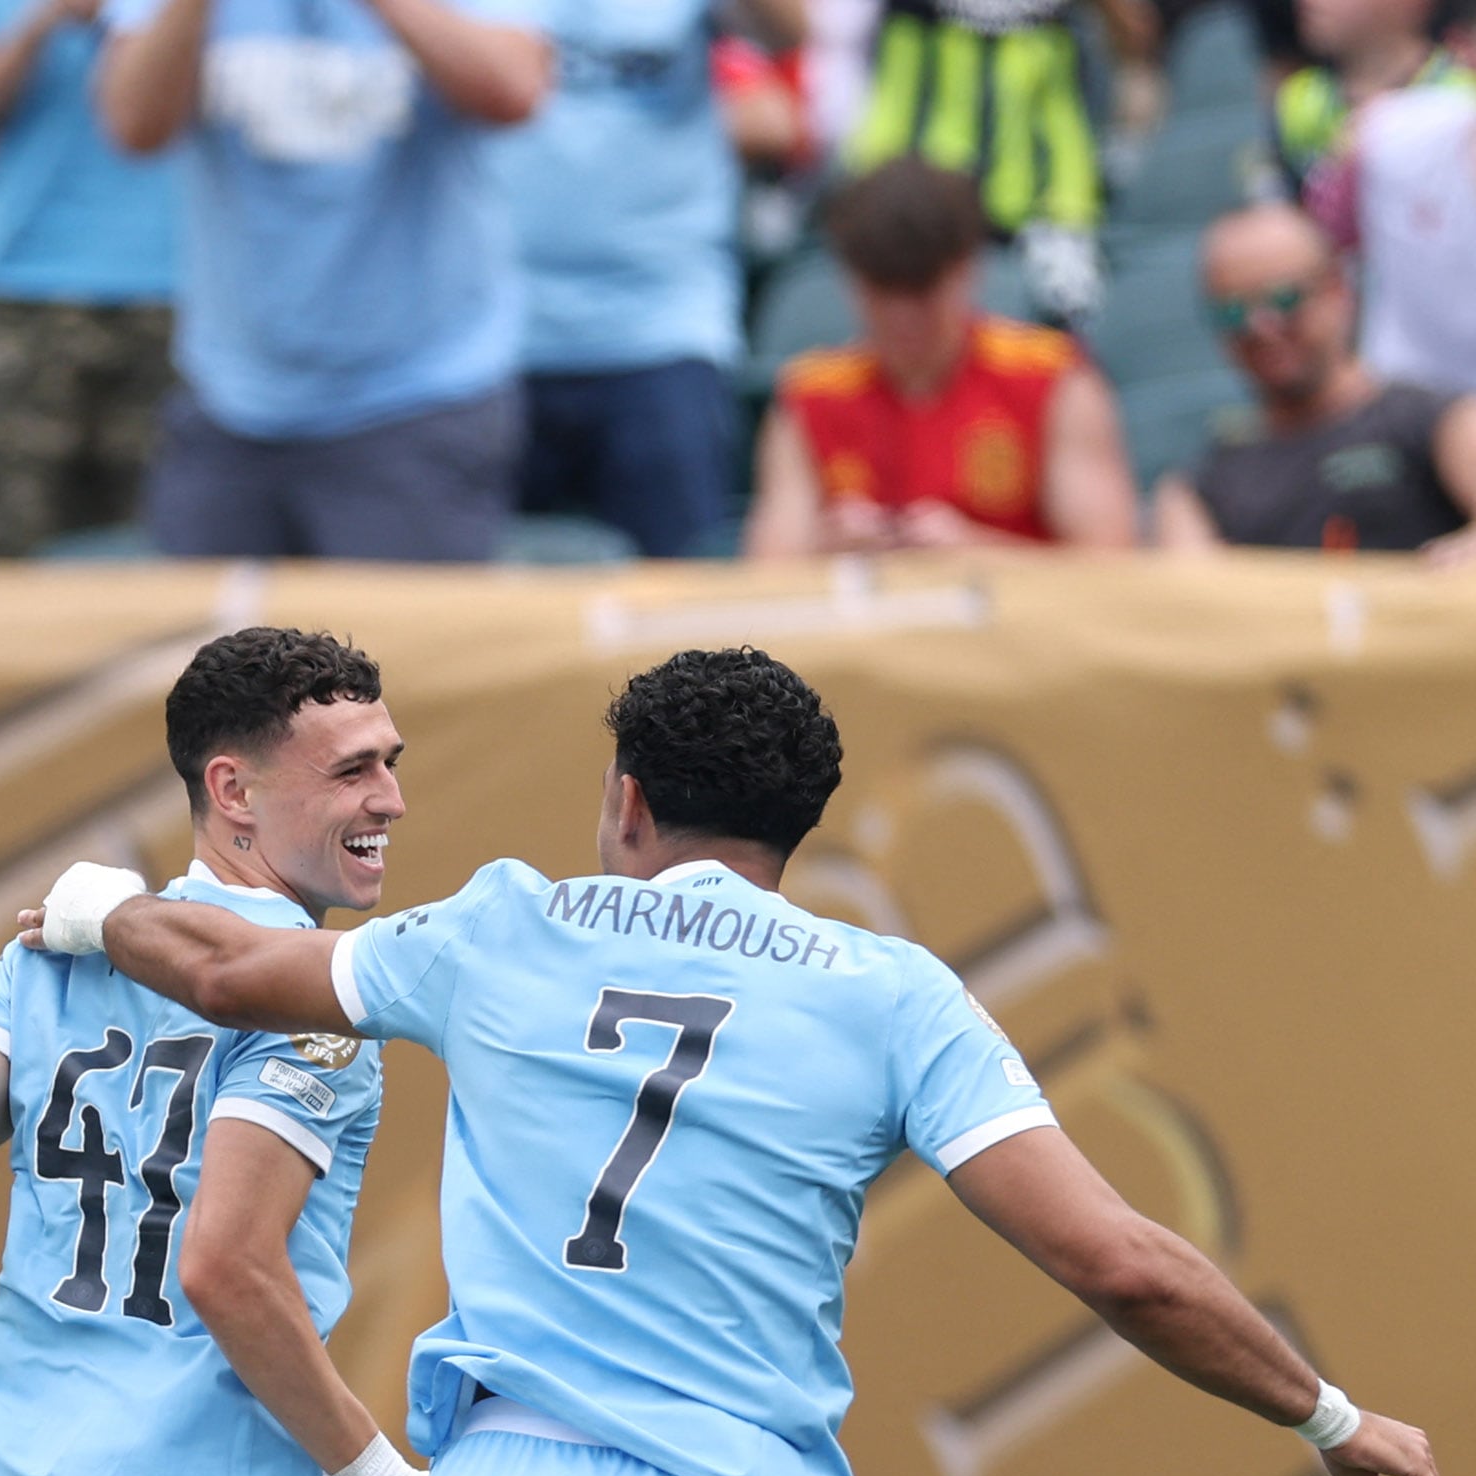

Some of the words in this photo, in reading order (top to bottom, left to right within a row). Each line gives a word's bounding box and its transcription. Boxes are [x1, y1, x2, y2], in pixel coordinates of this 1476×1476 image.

[233, 835, 252, 851] 47
[546, 882, 840, 970] MARMOUSH
[275, 1063, 311, 1086] FOOTBALL
[304, 1042, 335, 1064] FIFA
[562, 986, 736, 1272] 7
[35, 1026, 215, 1328] 47
